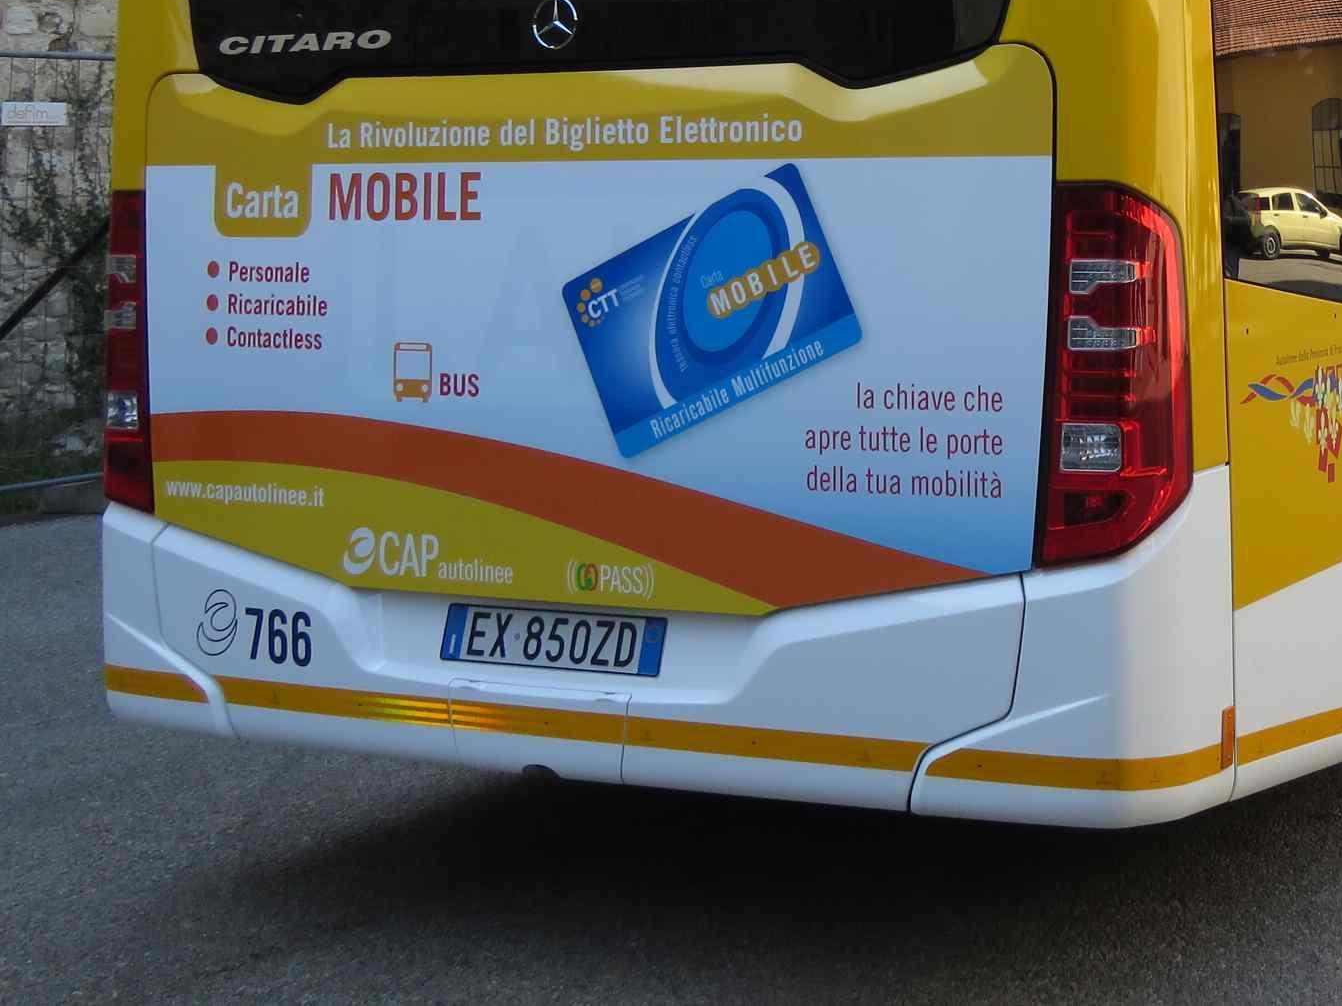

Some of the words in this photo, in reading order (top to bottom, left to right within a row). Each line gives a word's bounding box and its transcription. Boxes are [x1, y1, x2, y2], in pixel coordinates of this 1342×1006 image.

[218, 30, 392, 56] CITARO
[327, 123, 351, 150] La
[360, 118, 491, 149] Rivoluzione
[500, 118, 535, 146] del
[545, 114, 649, 152] Biglietto
[659, 113, 802, 145] Elettronico
[225, 181, 299, 219] Carta
[328, 171, 482, 222] MOBILE
[228, 260, 310, 284] Personale
[710, 243, 818, 318] MOBILE
[227, 293, 329, 318] Ricaricabile
[588, 288, 619, 319] CTT
[226, 326, 323, 351] Contactless
[438, 372, 480, 398] BUS
[650, 389, 731, 440] Ricaricabile
[729, 338, 824, 396] Multifunzione
[856, 381, 874, 410] la
[883, 383, 956, 412] chiave
[963, 384, 1003, 413] che
[804, 427, 852, 456] apre
[858, 425, 911, 453] tutte
[919, 426, 938, 454] le
[946, 428, 1003, 459] porte
[166, 478, 326, 508] www.capautolinee.it
[805, 465, 858, 494] della
[865, 467, 901, 496] tua
[911, 467, 1002, 499] mobilità
[378, 530, 439, 578] CAP
[438, 556, 514, 586] autolinee
[244, 606, 313, 667] 766
[466, 611, 513, 658] EX
[522, 615, 638, 668] 850ZD
